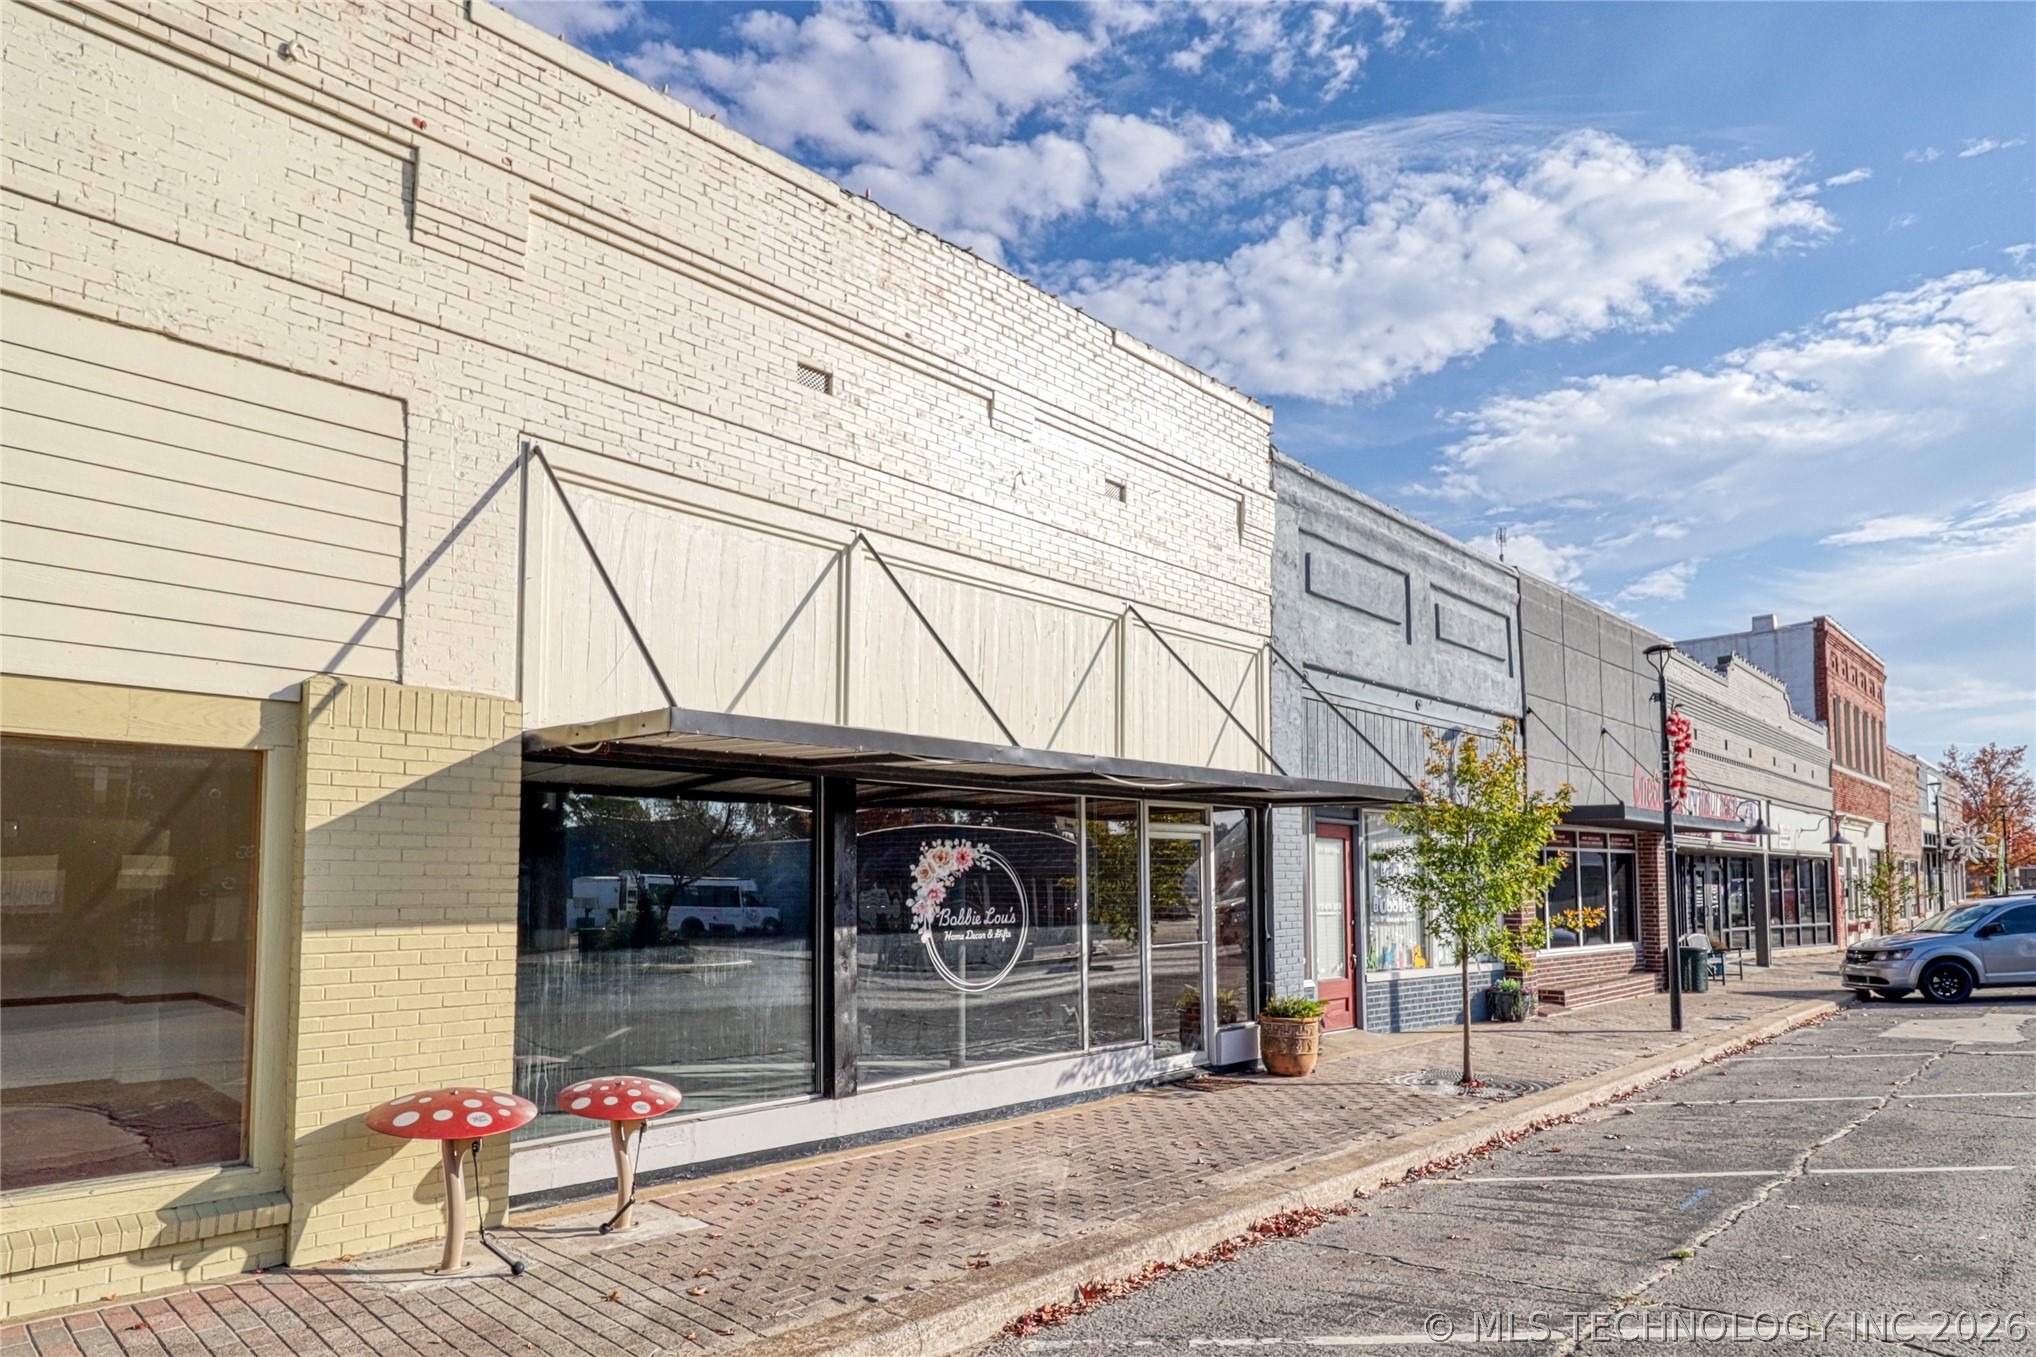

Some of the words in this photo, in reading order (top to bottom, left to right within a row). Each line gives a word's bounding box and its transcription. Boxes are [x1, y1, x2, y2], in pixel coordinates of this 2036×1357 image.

[936, 907, 982, 926] Bobbie
[983, 906, 1016, 925] Lou's
[944, 930, 965, 941] Home
[965, 929, 986, 940] Decor
[986, 928, 994, 939] &
[994, 928, 1012, 942] Gifts
